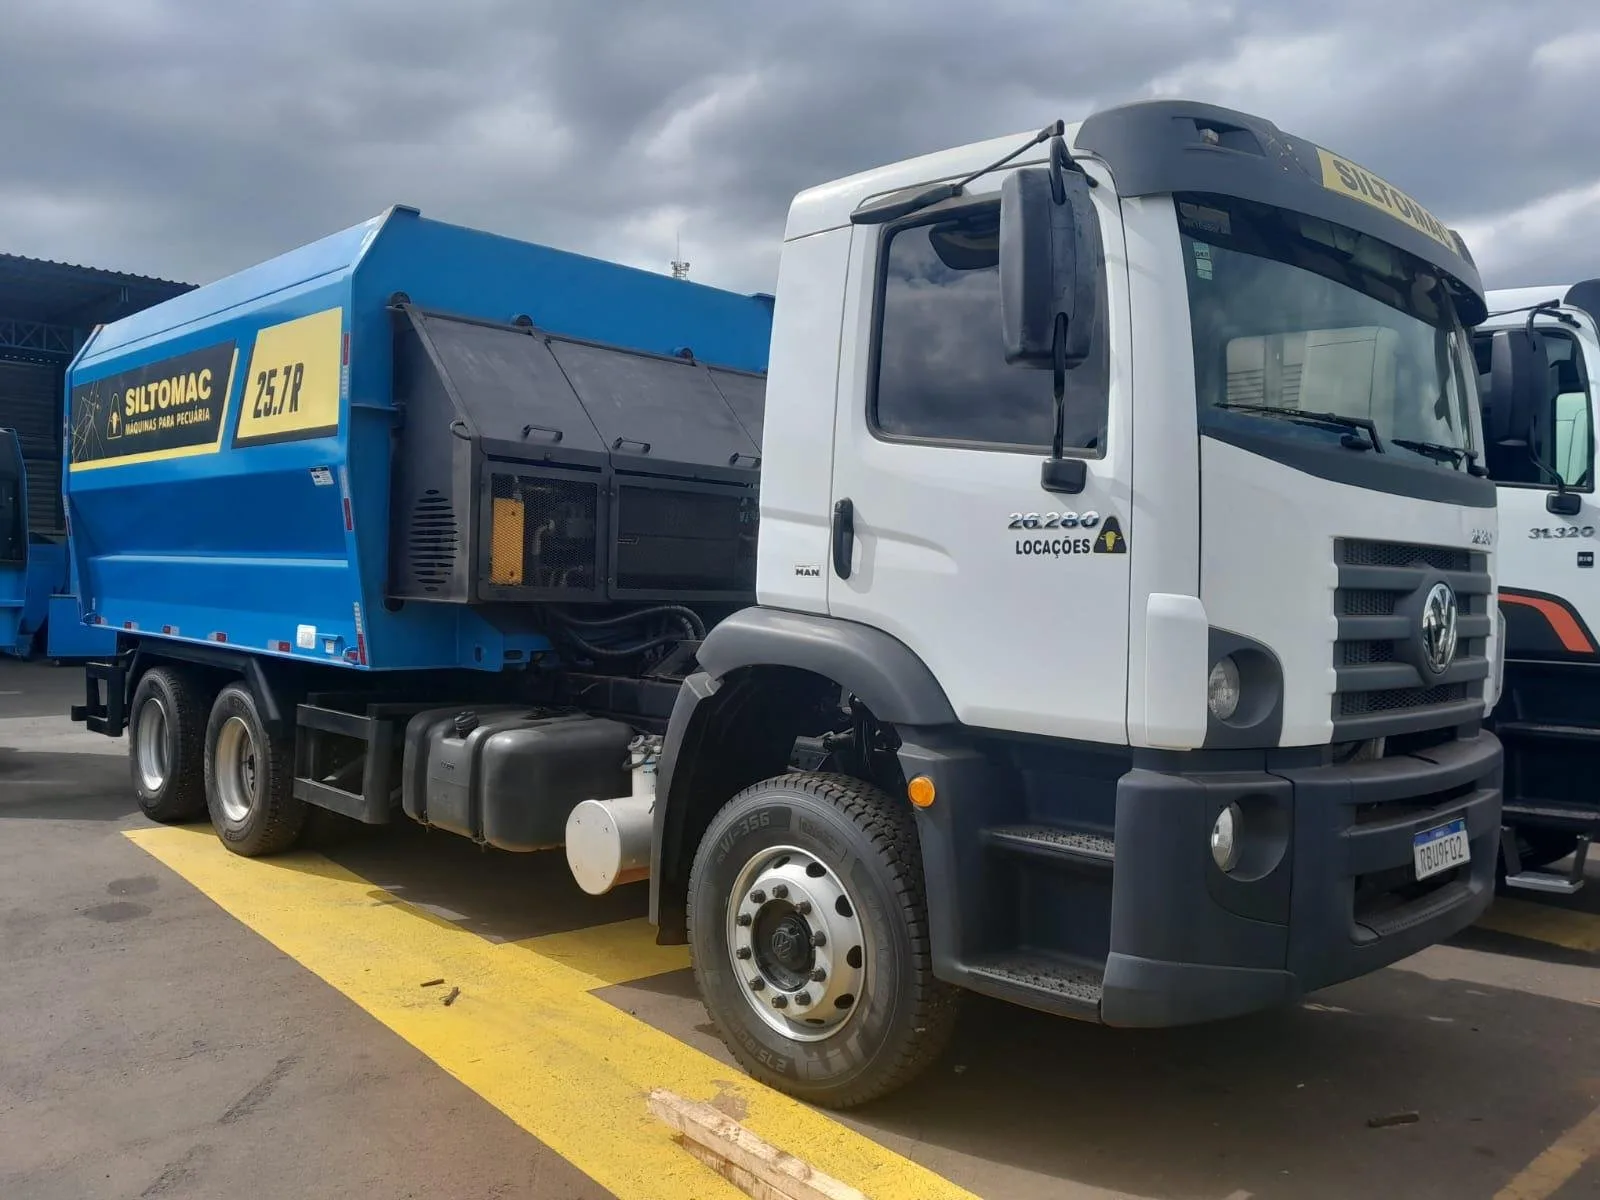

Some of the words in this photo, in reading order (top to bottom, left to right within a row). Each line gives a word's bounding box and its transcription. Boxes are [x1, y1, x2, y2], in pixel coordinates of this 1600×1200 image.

[125, 368, 212, 416] SILTOMAC
[253, 362, 304, 419] 25.7R
[125, 418, 157, 436] MÁQUINAS
[158, 416, 175, 429] PARA
[177, 406, 210, 426] PECUÁRIA
[1016, 536, 1091, 558] LOCAÇÕES
[795, 568, 820, 577] MAN
